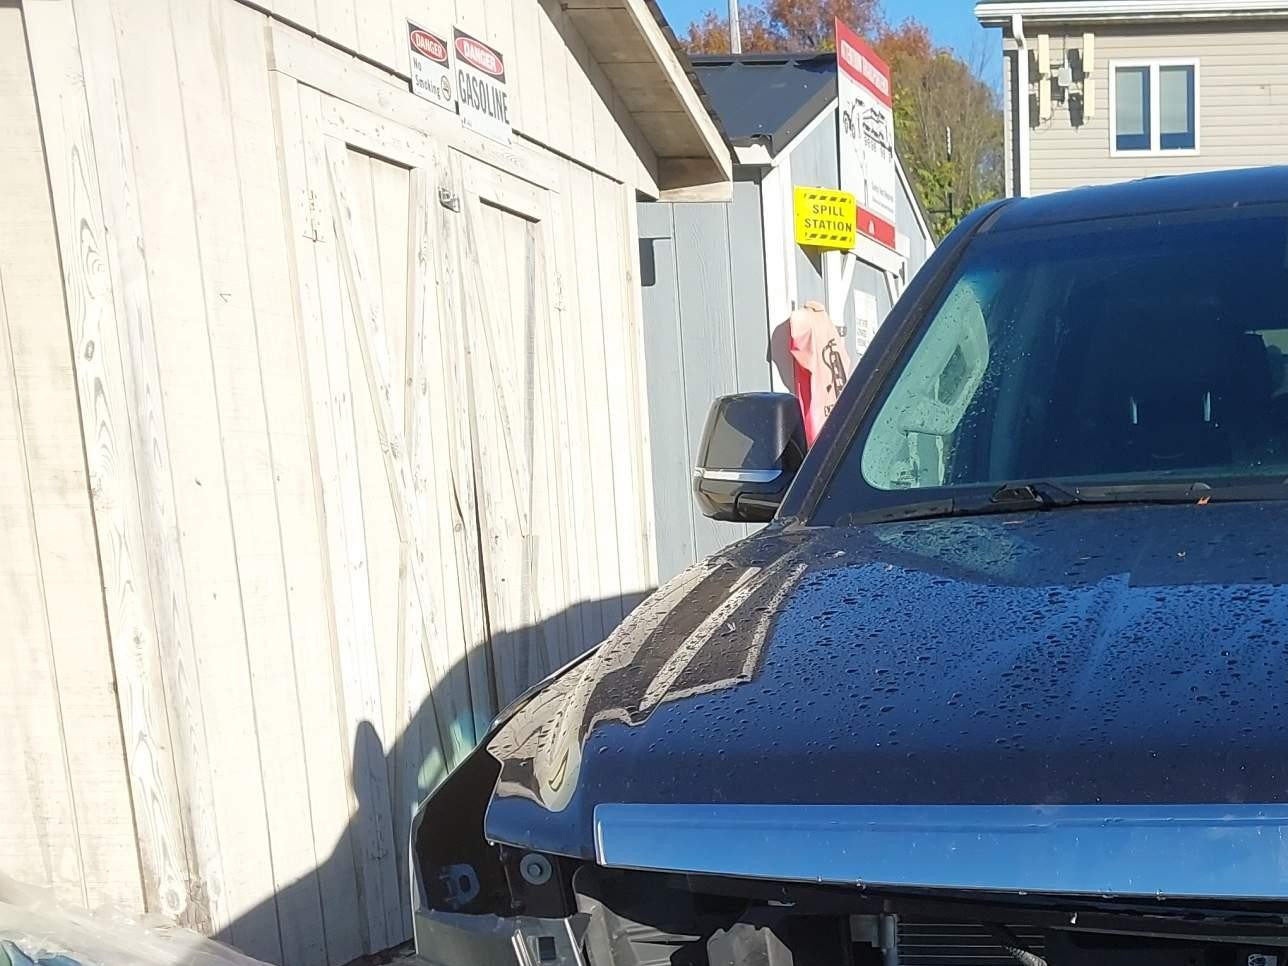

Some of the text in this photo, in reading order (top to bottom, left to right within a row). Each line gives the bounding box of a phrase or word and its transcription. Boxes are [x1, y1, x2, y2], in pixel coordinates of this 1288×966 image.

[415, 32, 443, 58] DANGER
[462, 40, 497, 72] DANGER
[415, 74, 441, 100] Smoking
[458, 69, 510, 125] GASOLINE
[812, 203, 845, 217] SPILL
[804, 218, 853, 233] STATION
